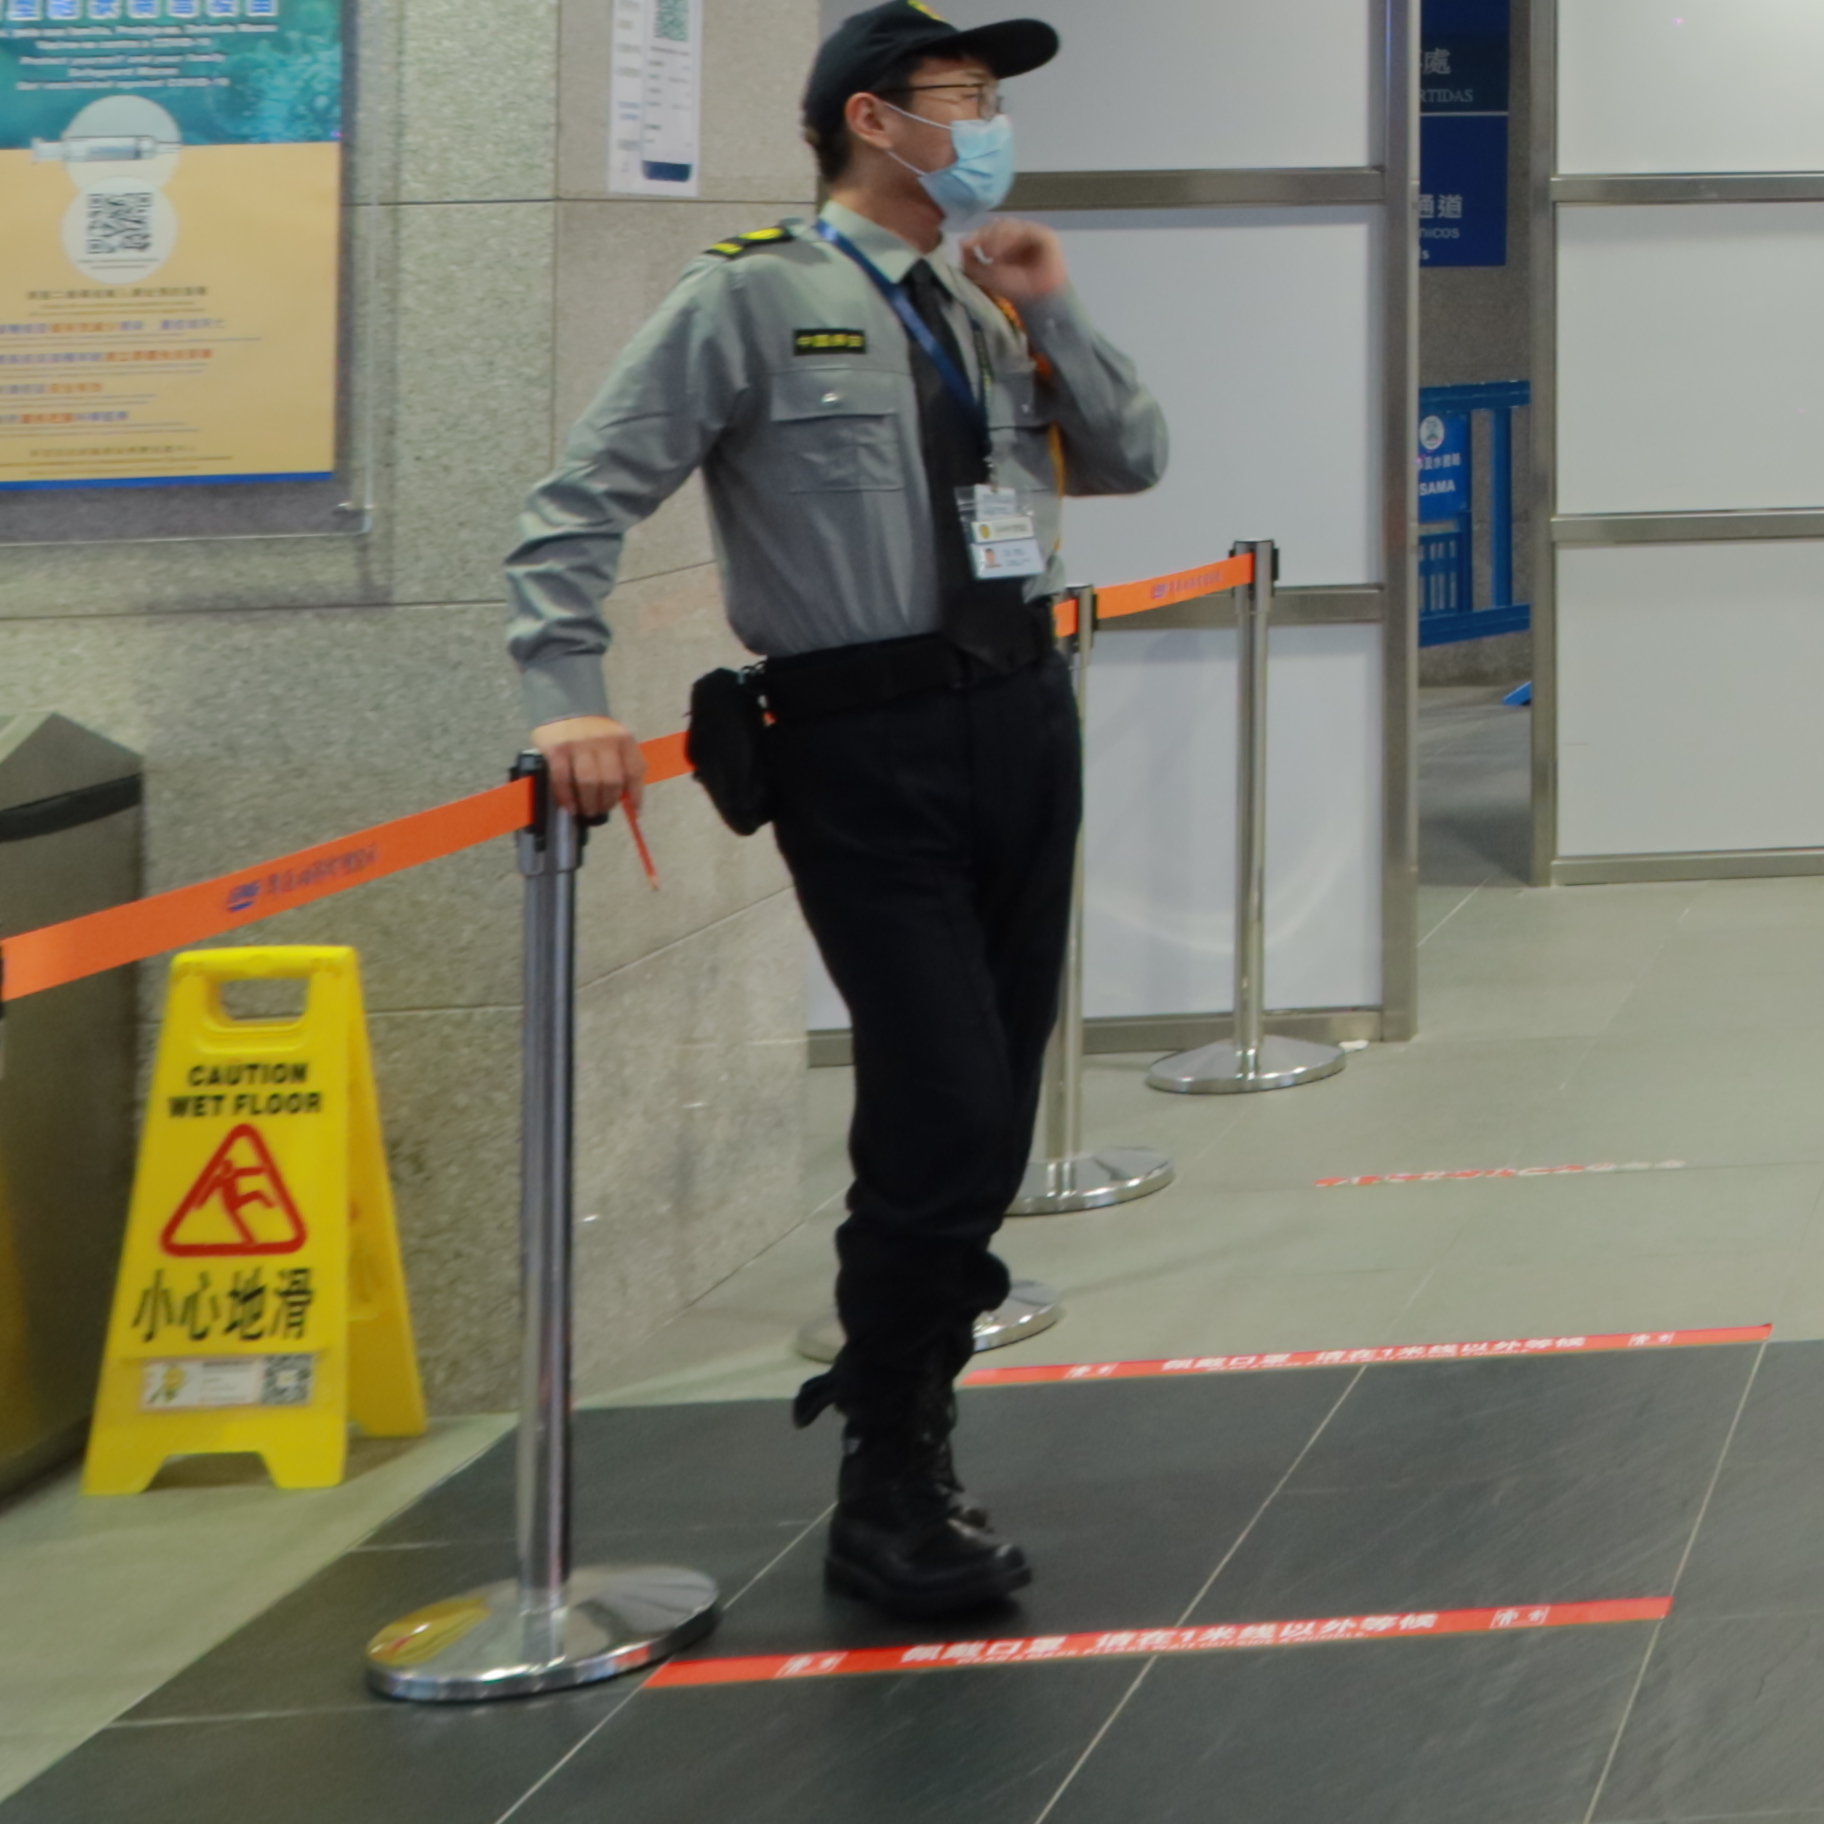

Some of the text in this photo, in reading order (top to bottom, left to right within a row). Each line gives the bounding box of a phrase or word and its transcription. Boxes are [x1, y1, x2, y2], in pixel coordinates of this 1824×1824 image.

[186, 1061, 309, 1087] CAUTION
[167, 1090, 323, 1119] WET FLOOR
[131, 1266, 315, 1343] 小心地滑
